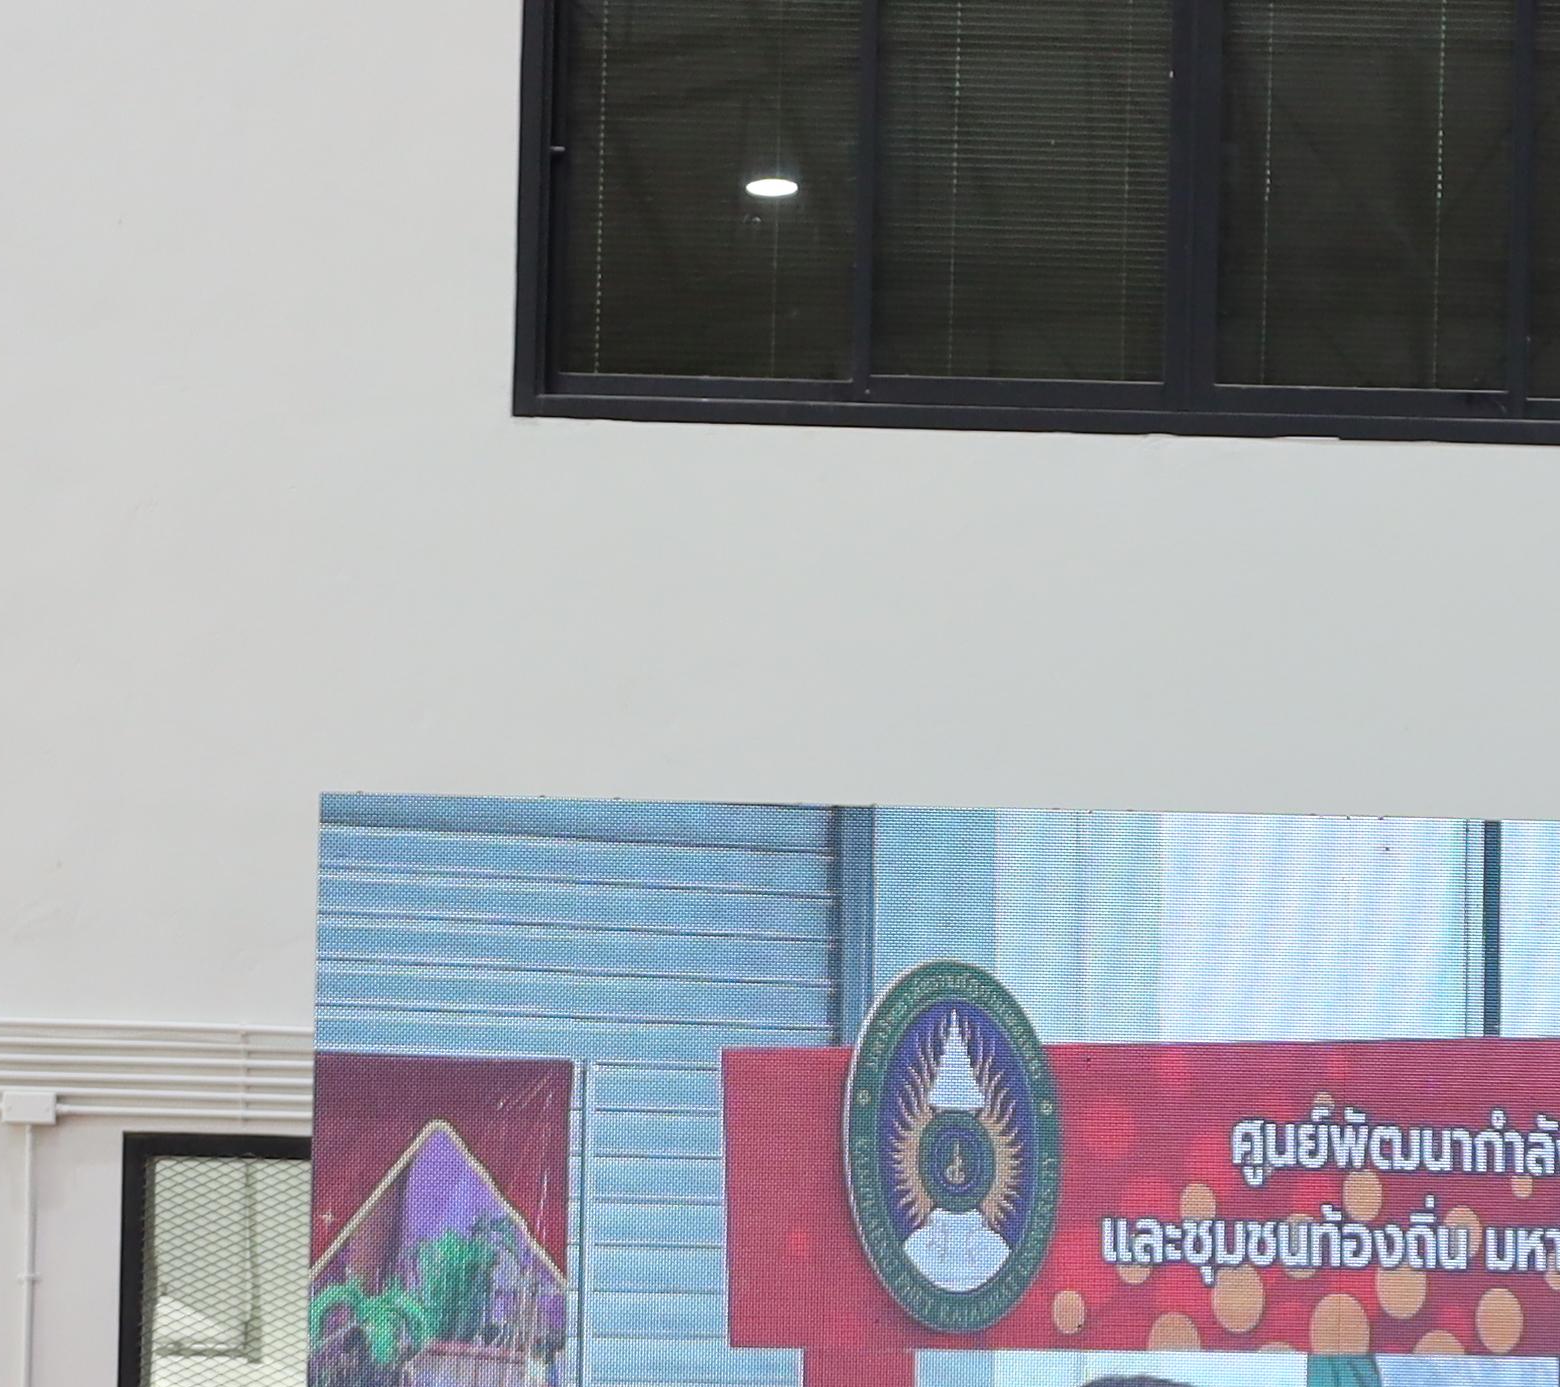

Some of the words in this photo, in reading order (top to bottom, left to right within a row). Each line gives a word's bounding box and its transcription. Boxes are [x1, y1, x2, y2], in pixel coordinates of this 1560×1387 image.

[1101, 1194, 1470, 1286] และชุมชนท้องถิ่น
